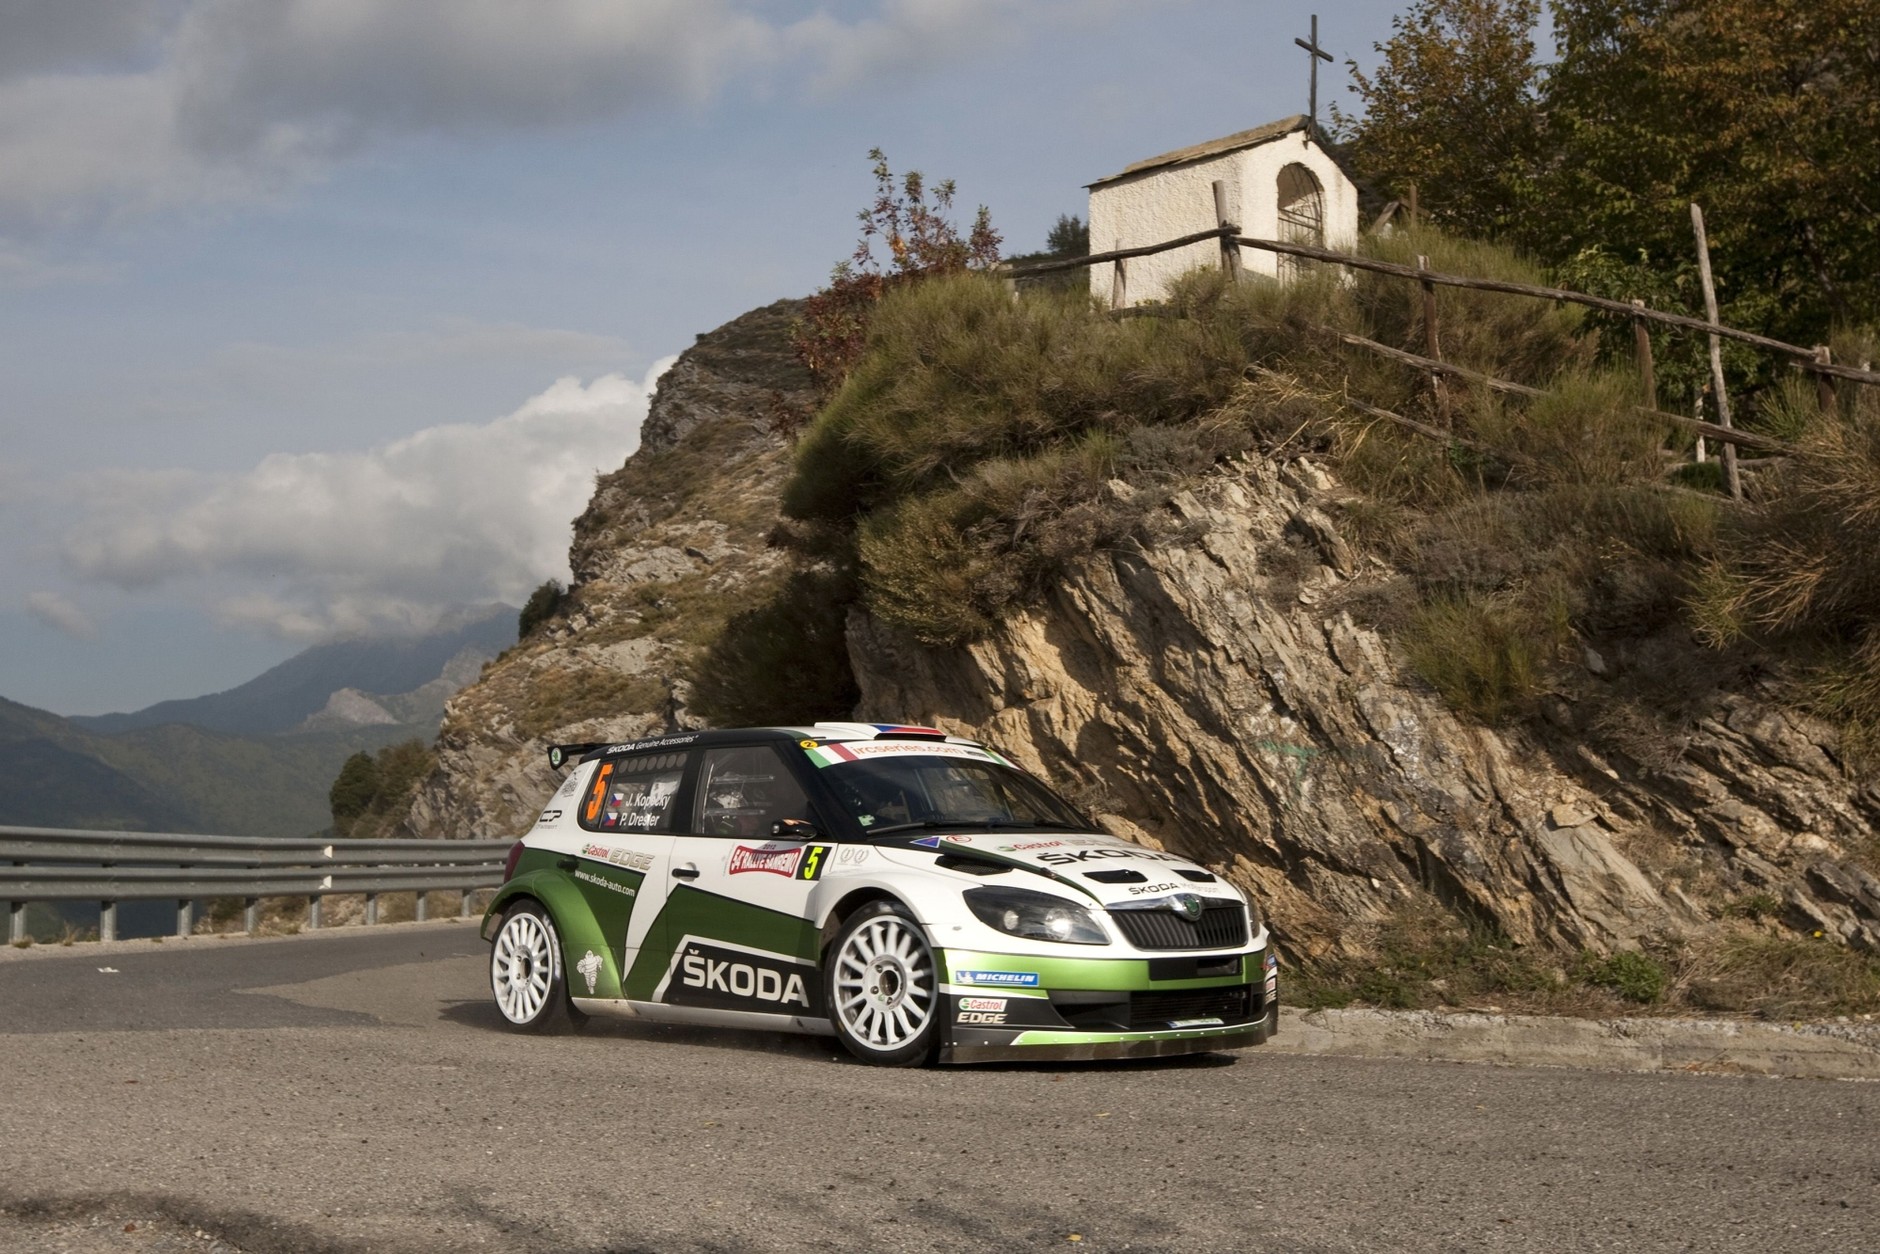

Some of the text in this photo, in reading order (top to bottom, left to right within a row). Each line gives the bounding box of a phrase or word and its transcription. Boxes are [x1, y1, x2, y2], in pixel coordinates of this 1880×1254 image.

[850, 743, 964, 756] ircseries.com
[586, 763, 615, 821] 5
[625, 793, 634, 807] J.
[619, 812, 628, 826] P.
[587, 845, 656, 871] Castrol EDGE
[804, 846, 823, 880] 5
[574, 870, 636, 897] www.skoda-auto.com
[683, 948, 810, 1008] ŠKODA
[975, 973, 1035, 982] MICHELIN
[970, 999, 1003, 1010] Castrol
[956, 1012, 1008, 1024] EDGE
